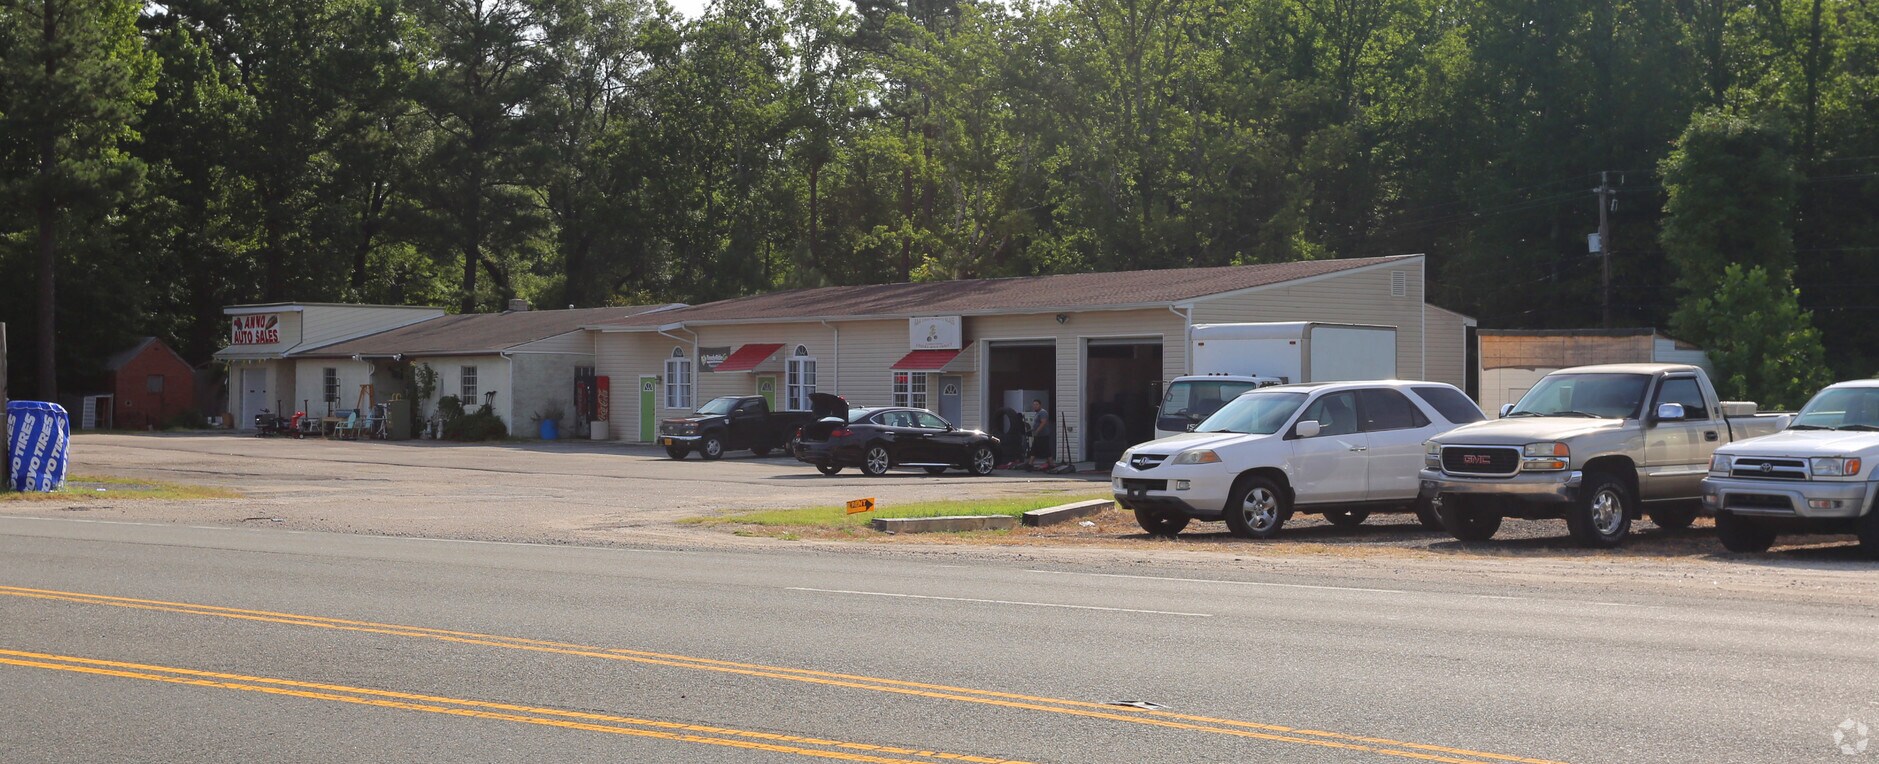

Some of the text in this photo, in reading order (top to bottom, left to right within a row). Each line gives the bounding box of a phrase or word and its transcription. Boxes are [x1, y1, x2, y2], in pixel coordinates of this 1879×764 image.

[234, 329, 279, 344] AUTO SALES
[15, 412, 35, 456] TIRES
[23, 414, 54, 491] OYO TIRES
[1463, 454, 1491, 464] GMC
[41, 458, 57, 492] OYO
